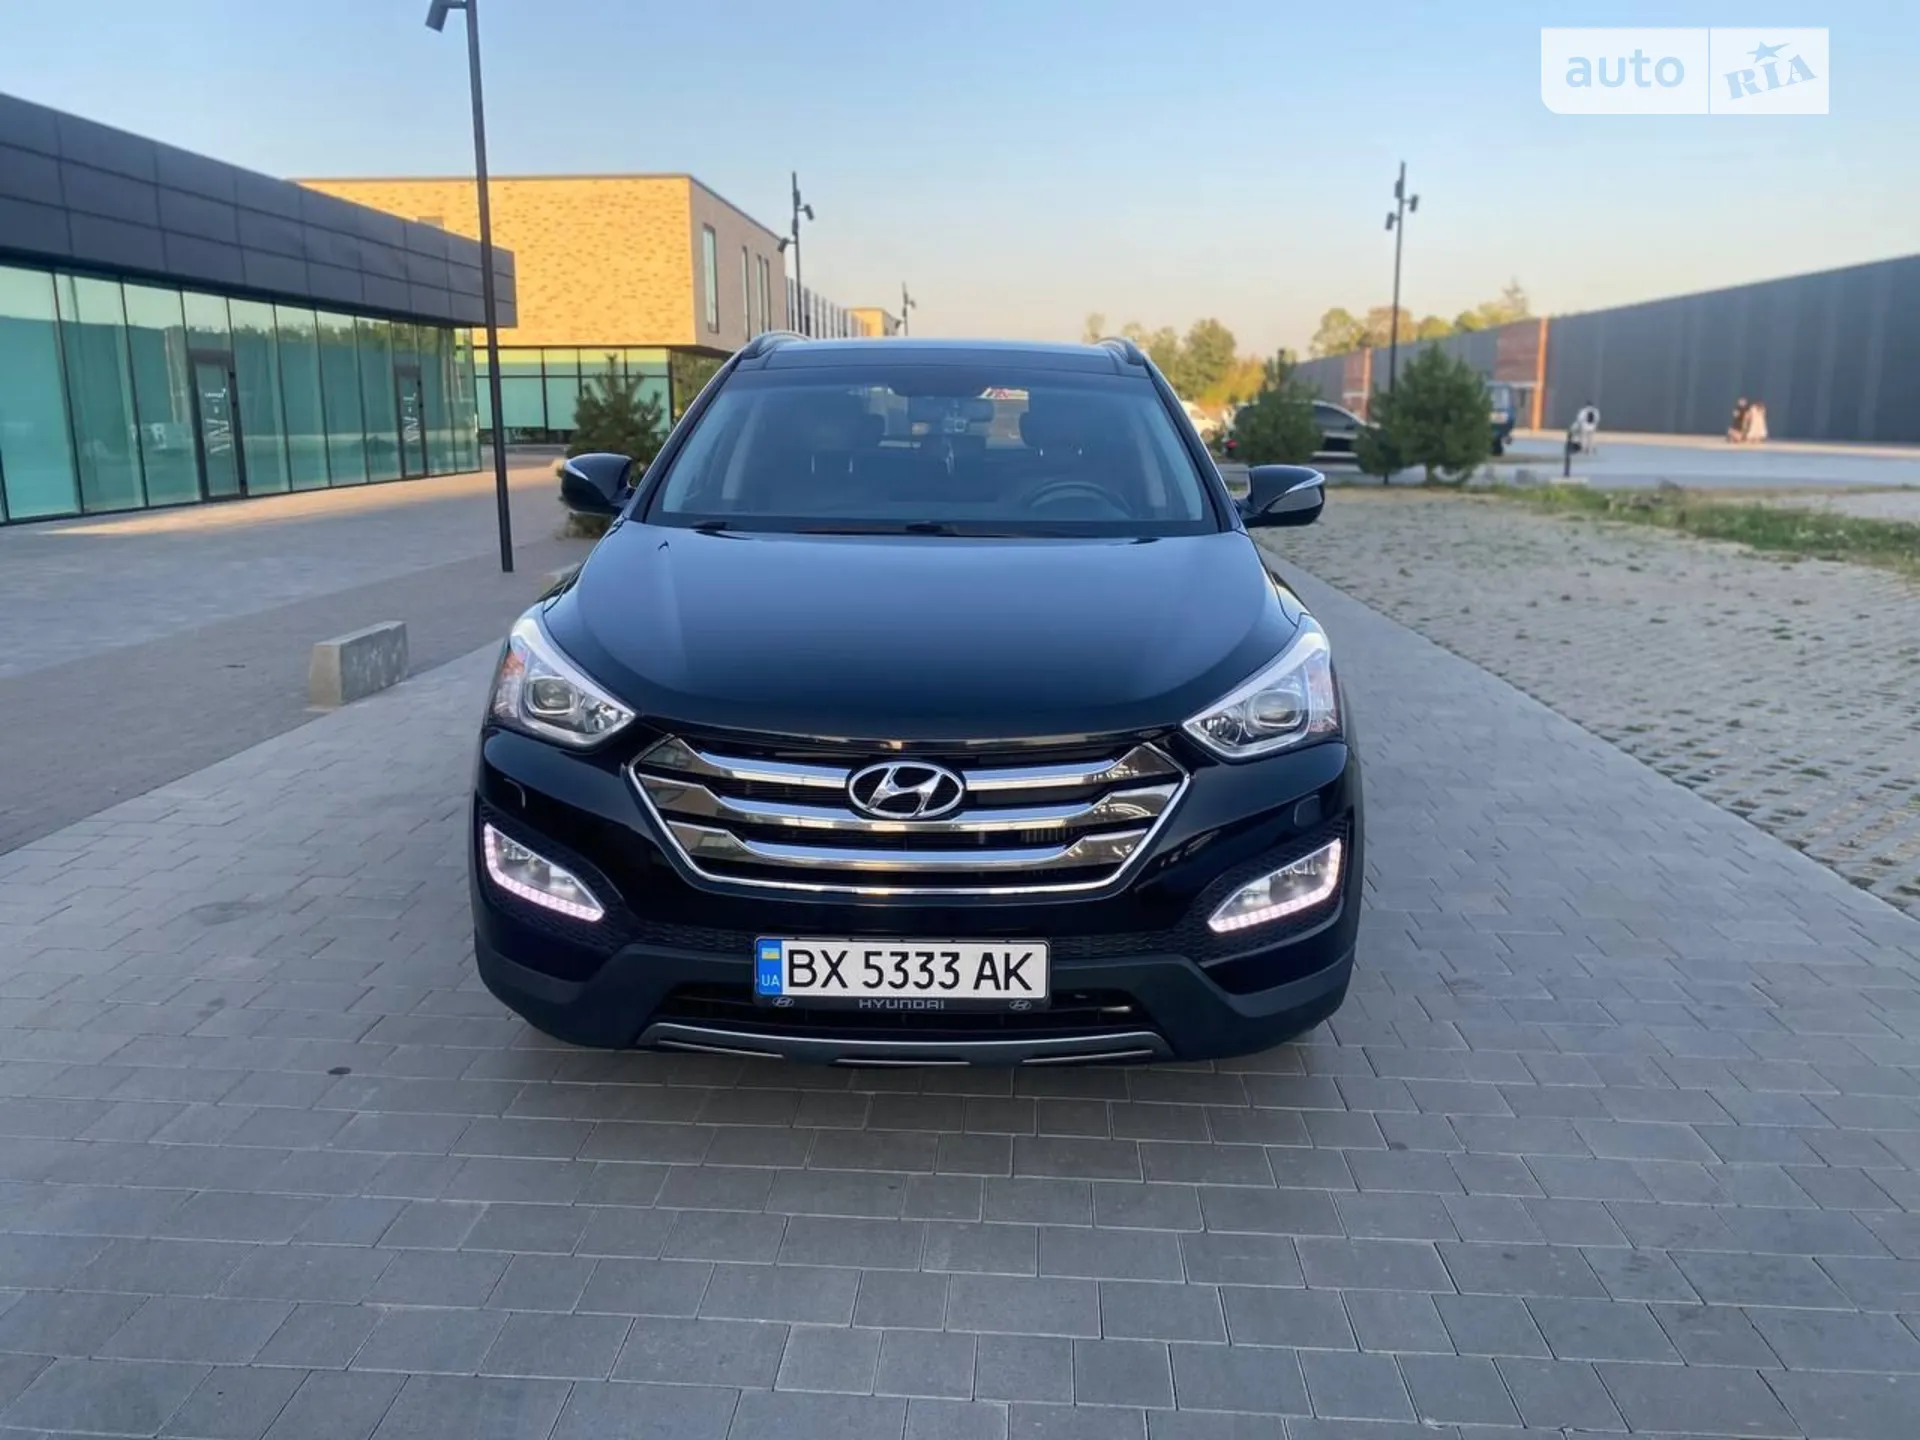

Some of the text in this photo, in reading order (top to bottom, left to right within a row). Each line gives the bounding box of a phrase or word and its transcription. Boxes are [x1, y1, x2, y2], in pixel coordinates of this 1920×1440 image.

[788, 949, 1033, 991] BX 5333 AK
[761, 974, 780, 987] UA
[858, 999, 945, 1010] HYUNDAI
